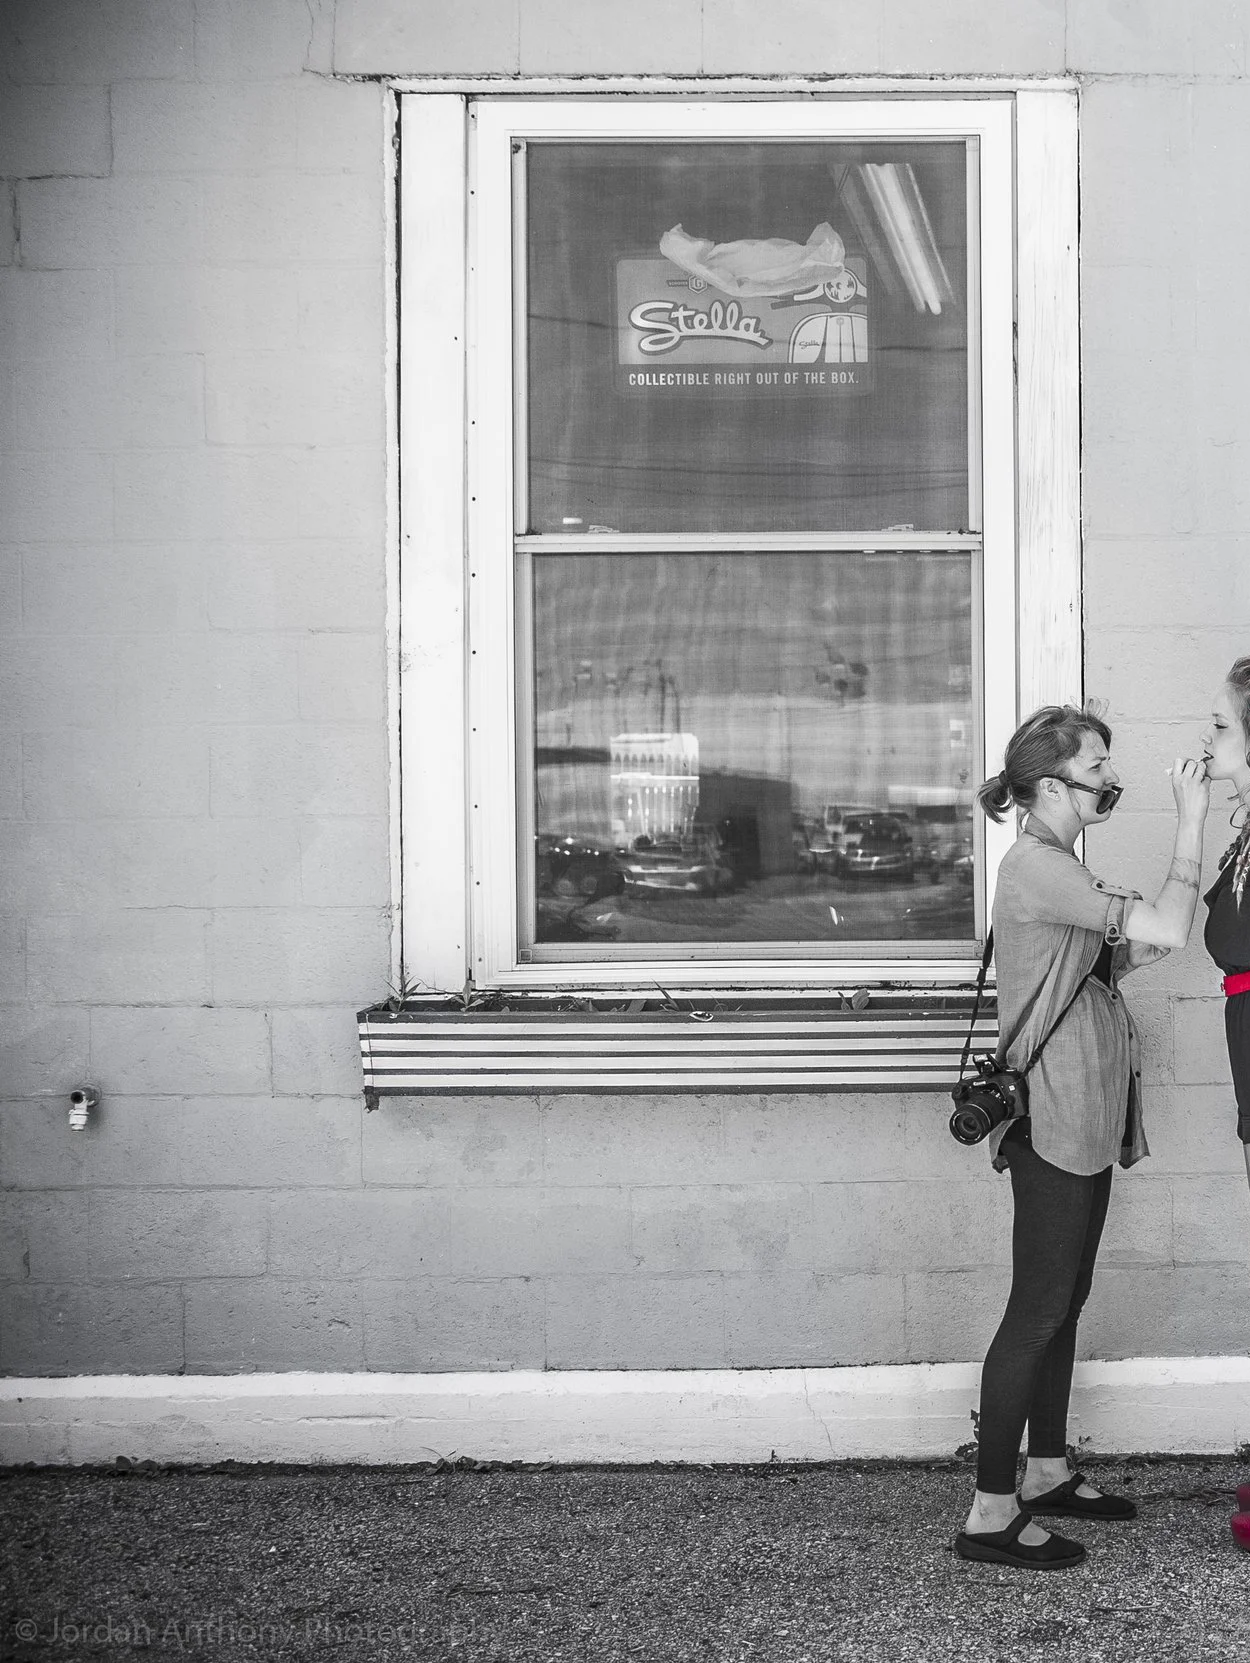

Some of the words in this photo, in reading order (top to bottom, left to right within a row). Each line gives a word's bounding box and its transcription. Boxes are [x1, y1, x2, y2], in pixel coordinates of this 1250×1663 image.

[629, 300, 772, 354] Stella
[629, 372, 709, 386] COLLECTIBLE
[714, 372, 750, 385] RIGHT
[756, 372, 778, 385] OUT
[784, 372, 799, 385] OF
[804, 372, 826, 384] THE
[831, 371, 859, 384] BOX.
